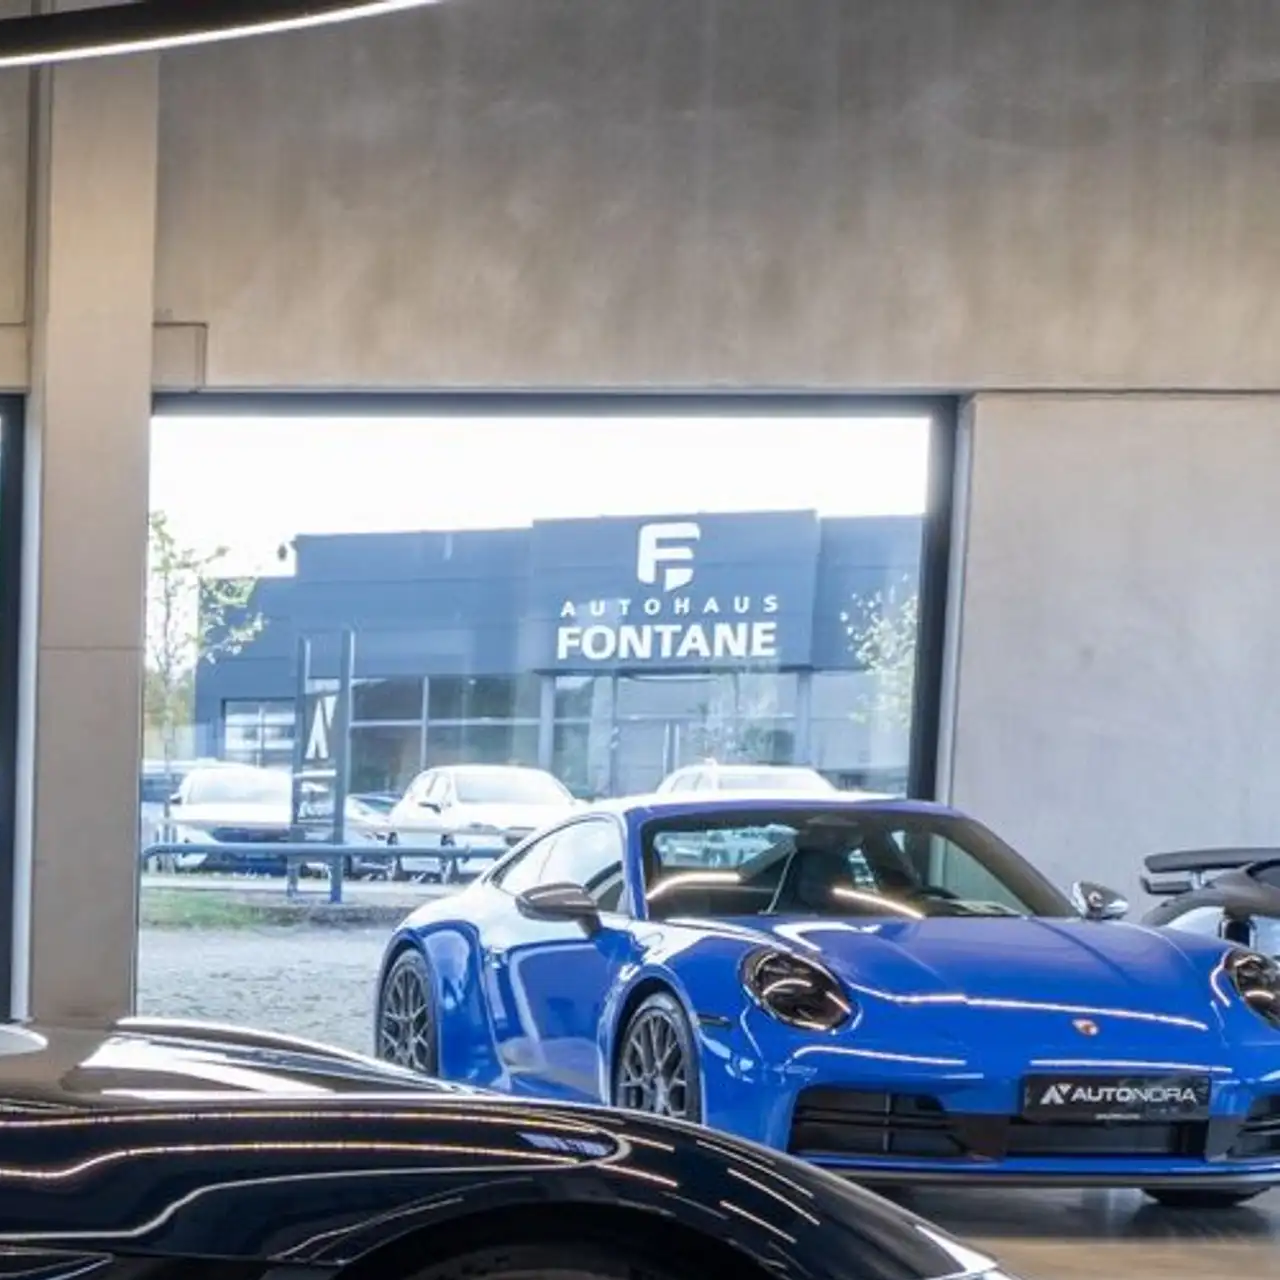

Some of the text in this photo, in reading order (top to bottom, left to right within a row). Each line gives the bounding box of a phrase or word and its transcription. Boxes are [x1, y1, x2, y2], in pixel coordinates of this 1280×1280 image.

[560, 595, 779, 617] AUTOHAUS
[556, 622, 777, 660] FONTANE
[1070, 1086, 1197, 1103] AUTONORA
